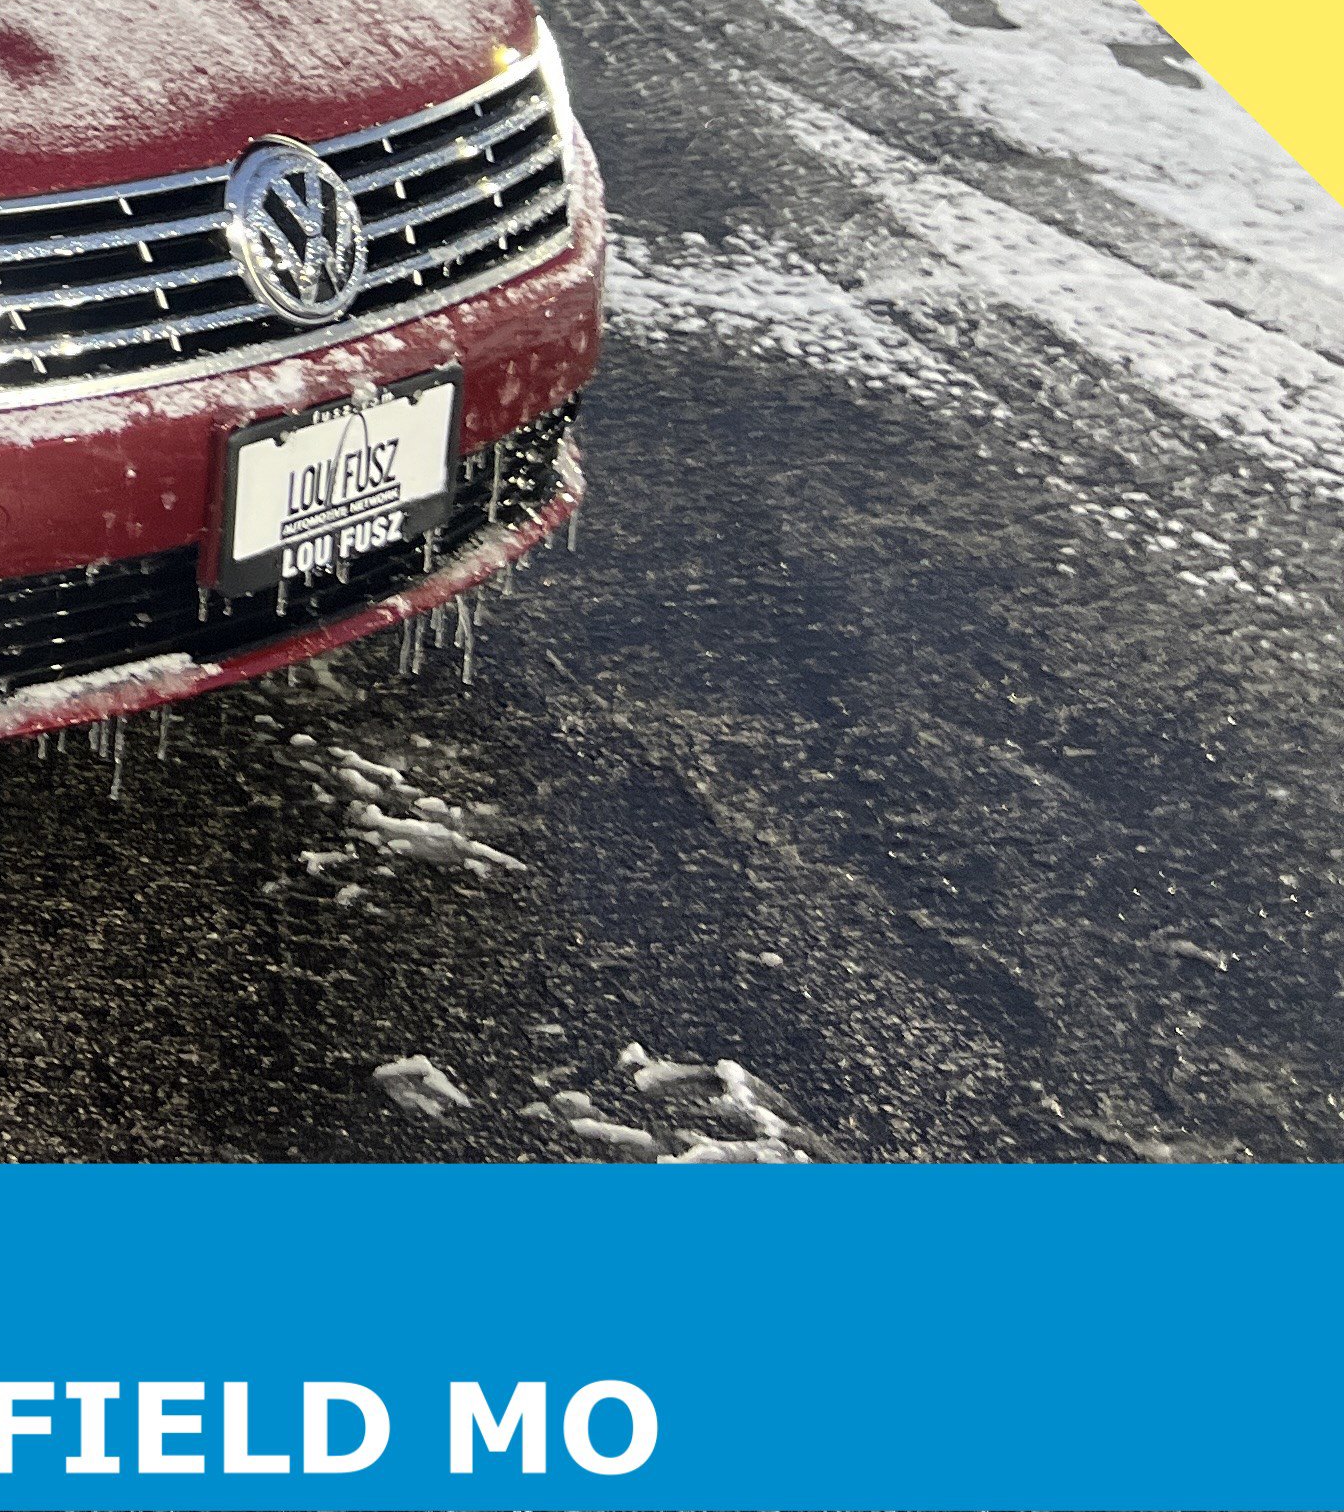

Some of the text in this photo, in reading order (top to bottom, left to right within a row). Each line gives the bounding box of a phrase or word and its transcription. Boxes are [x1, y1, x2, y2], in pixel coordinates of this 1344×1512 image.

[289, 438, 399, 516] LOU FUSZ
[282, 510, 405, 579] LOU FUSZ
